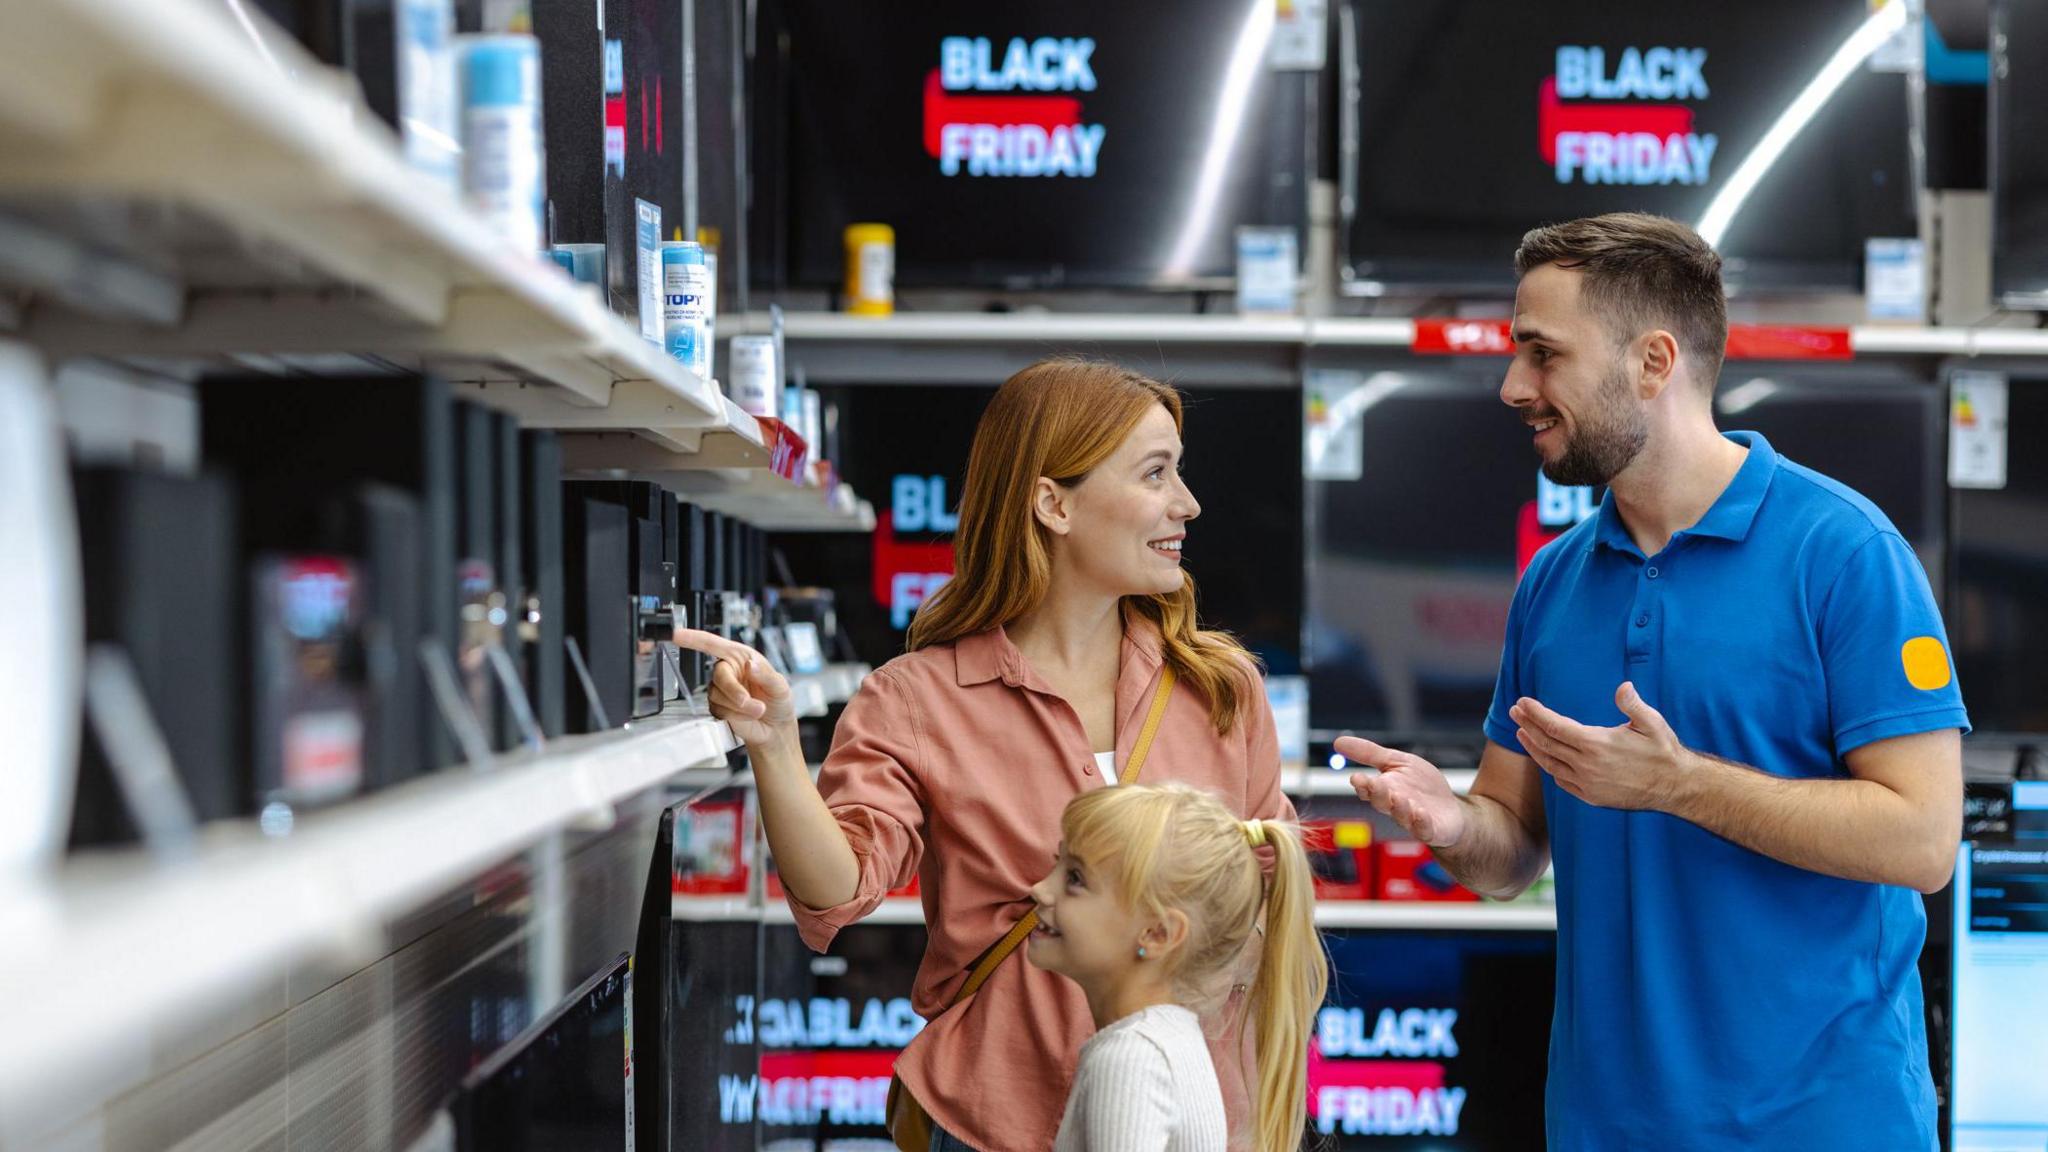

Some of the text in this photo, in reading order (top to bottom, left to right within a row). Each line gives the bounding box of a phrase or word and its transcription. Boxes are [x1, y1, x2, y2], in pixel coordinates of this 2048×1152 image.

[941, 36, 1097, 91] BLACK
[1555, 45, 1709, 99] BLACK
[941, 123, 1105, 177] FRIDAY
[1555, 131, 1718, 185] FRIDAY
[1318, 1008, 1459, 1057] BLACK
[1318, 1085, 1466, 1136] FRIDAY
